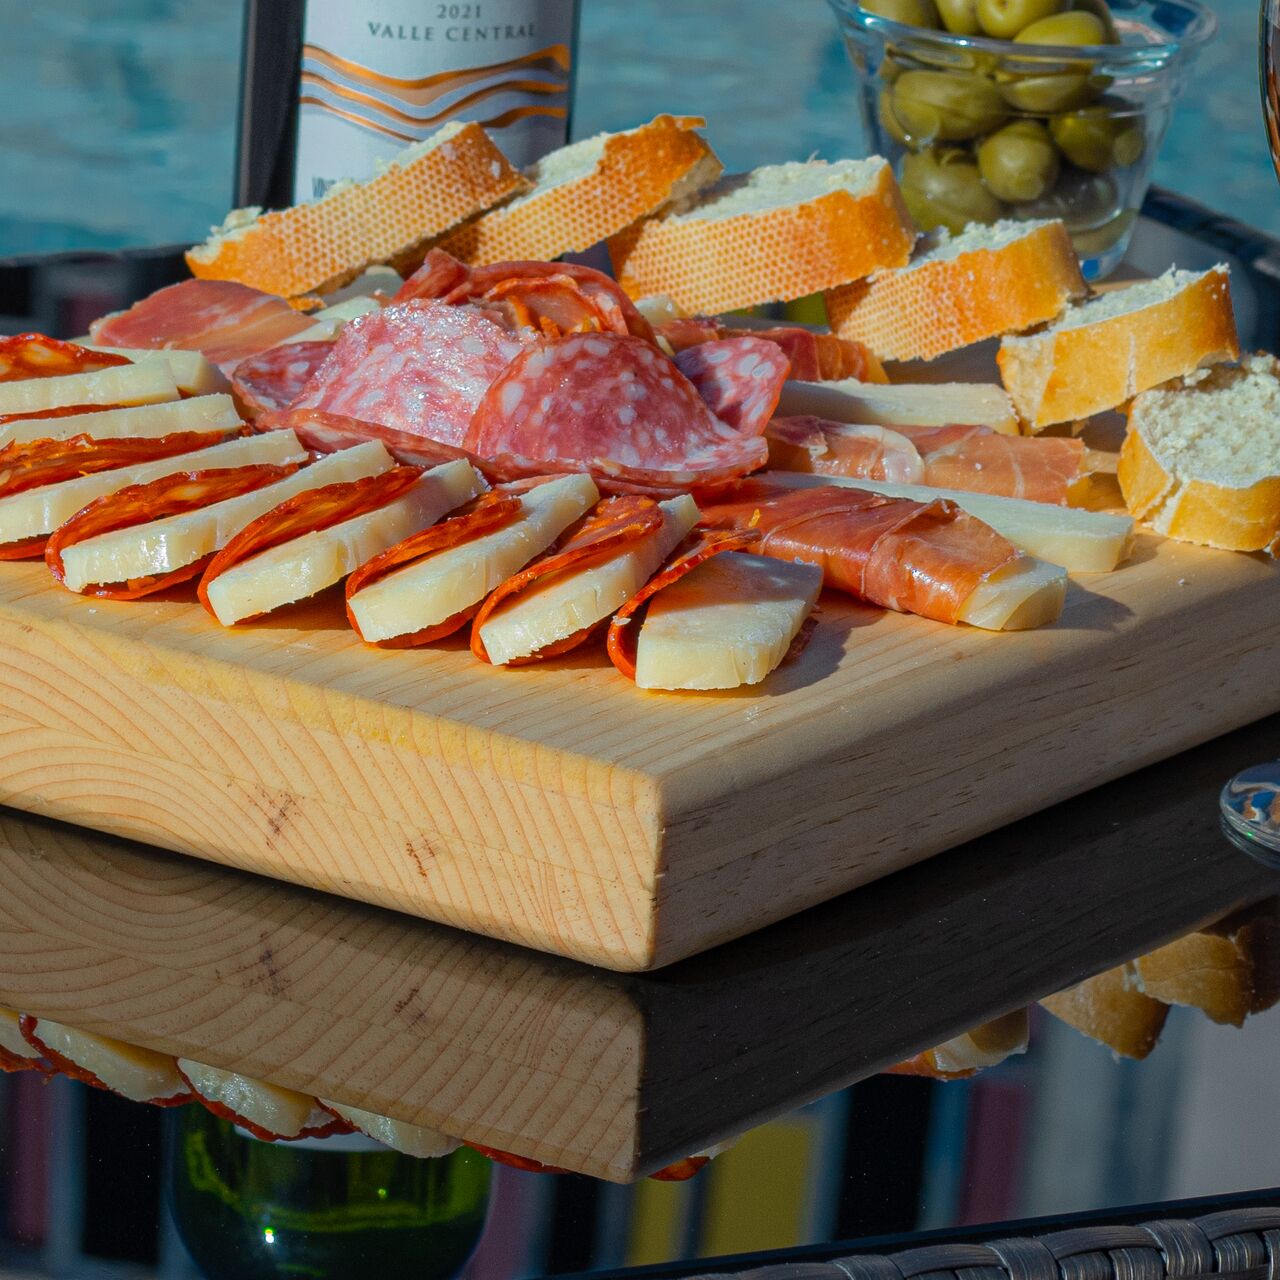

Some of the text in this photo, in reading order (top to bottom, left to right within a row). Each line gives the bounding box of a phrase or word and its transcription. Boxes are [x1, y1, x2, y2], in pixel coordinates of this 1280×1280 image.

[437, 3, 482, 20] 2021
[367, 21, 536, 42] VALLE CENTRAL
